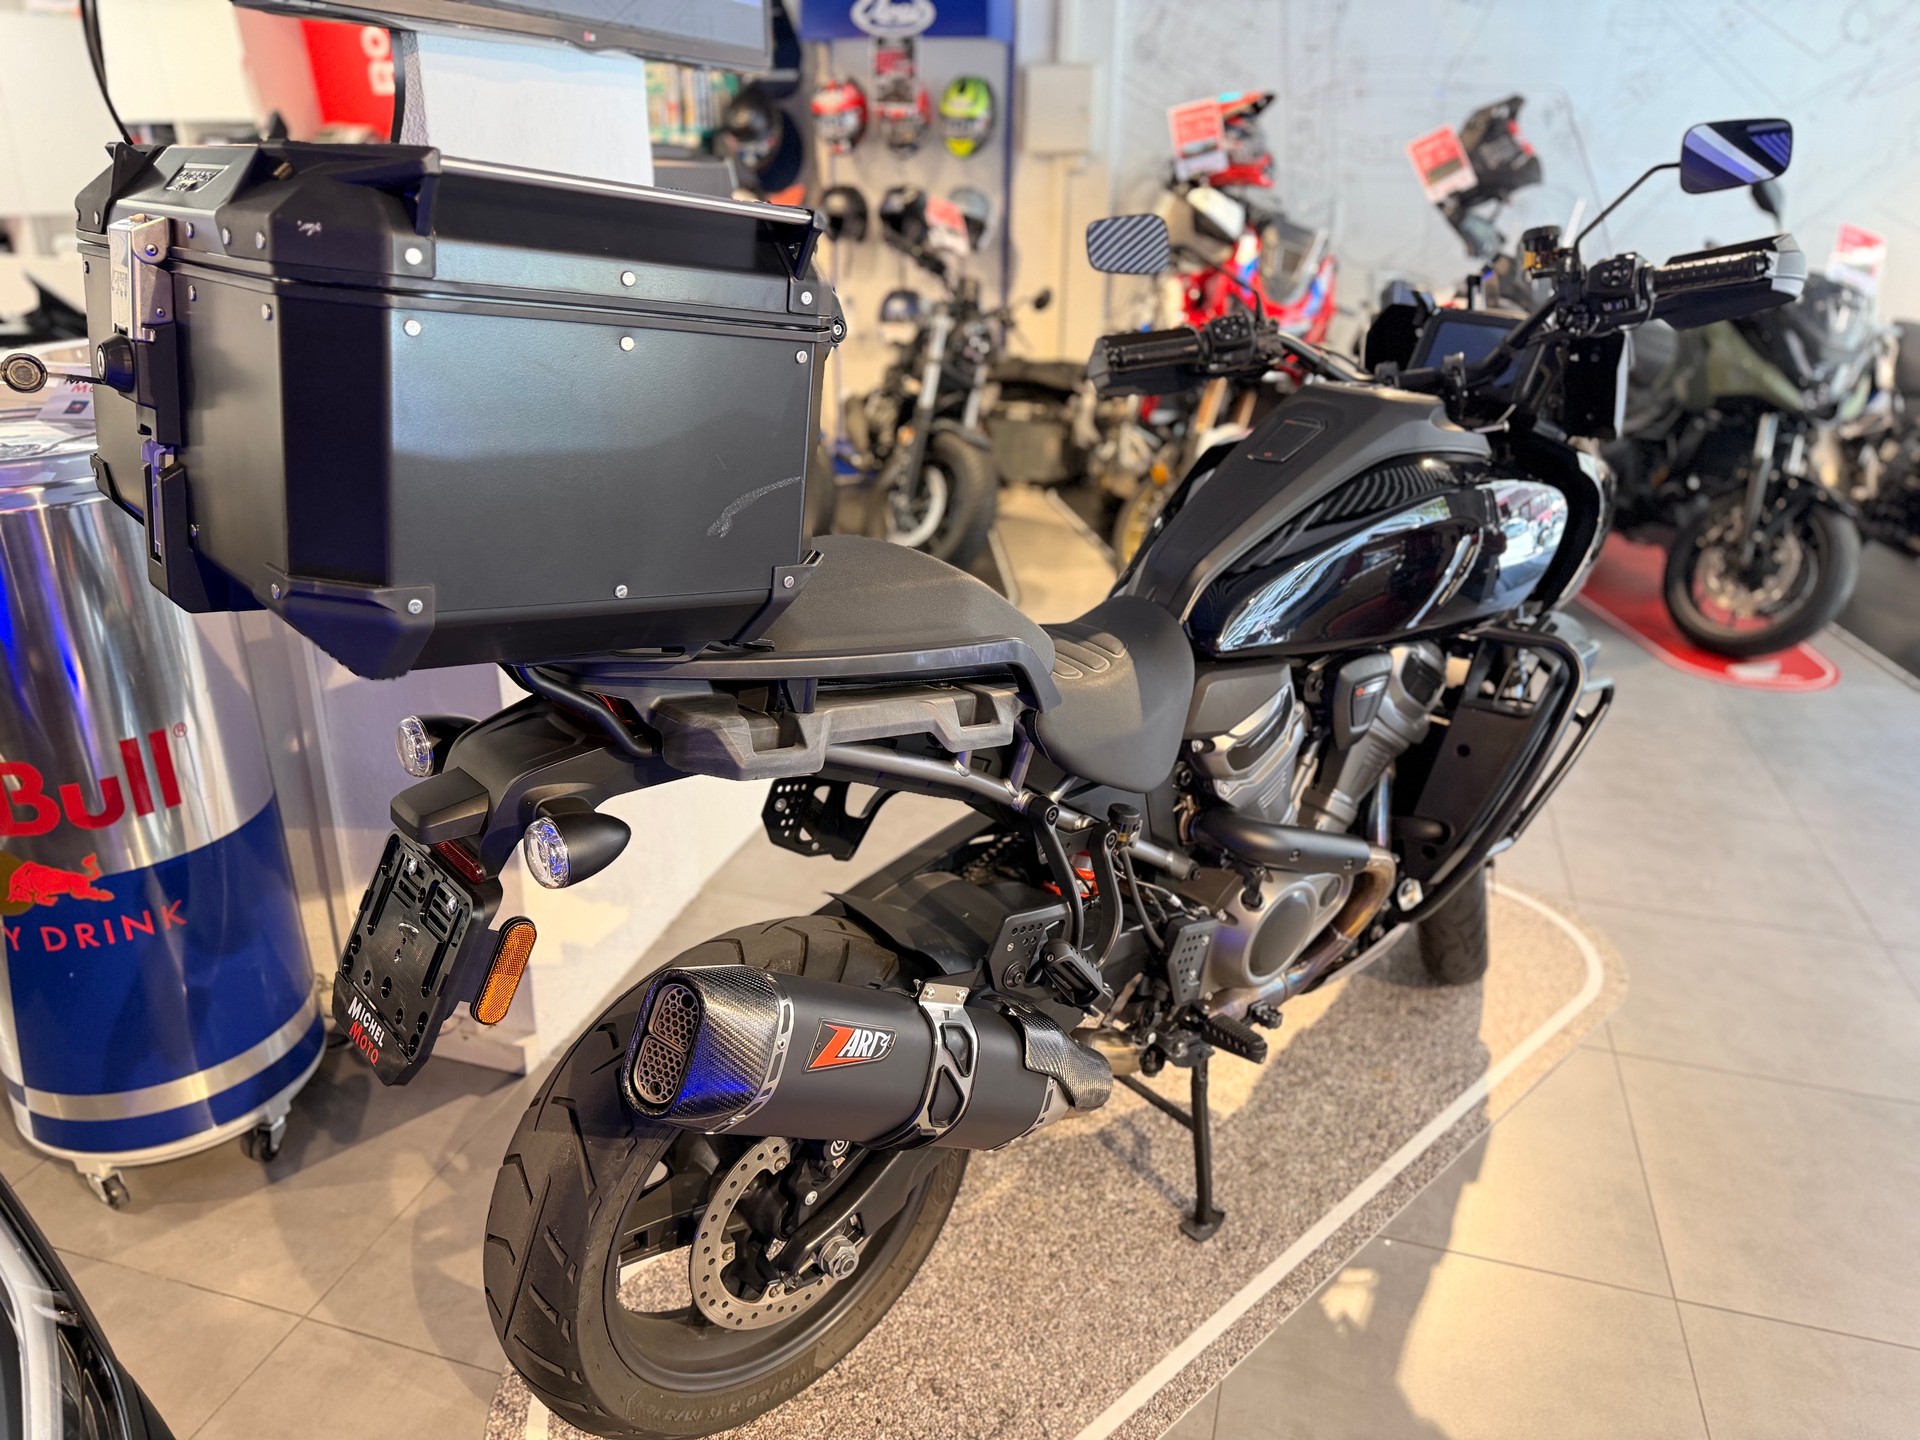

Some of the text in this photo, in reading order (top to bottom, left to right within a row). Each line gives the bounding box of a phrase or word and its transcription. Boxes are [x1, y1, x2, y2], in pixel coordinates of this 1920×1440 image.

[0, 728, 182, 837] Bull
[40, 899, 188, 952] DRINK
[347, 996, 385, 1048] MICHEL
[349, 1020, 380, 1067] MOTO
